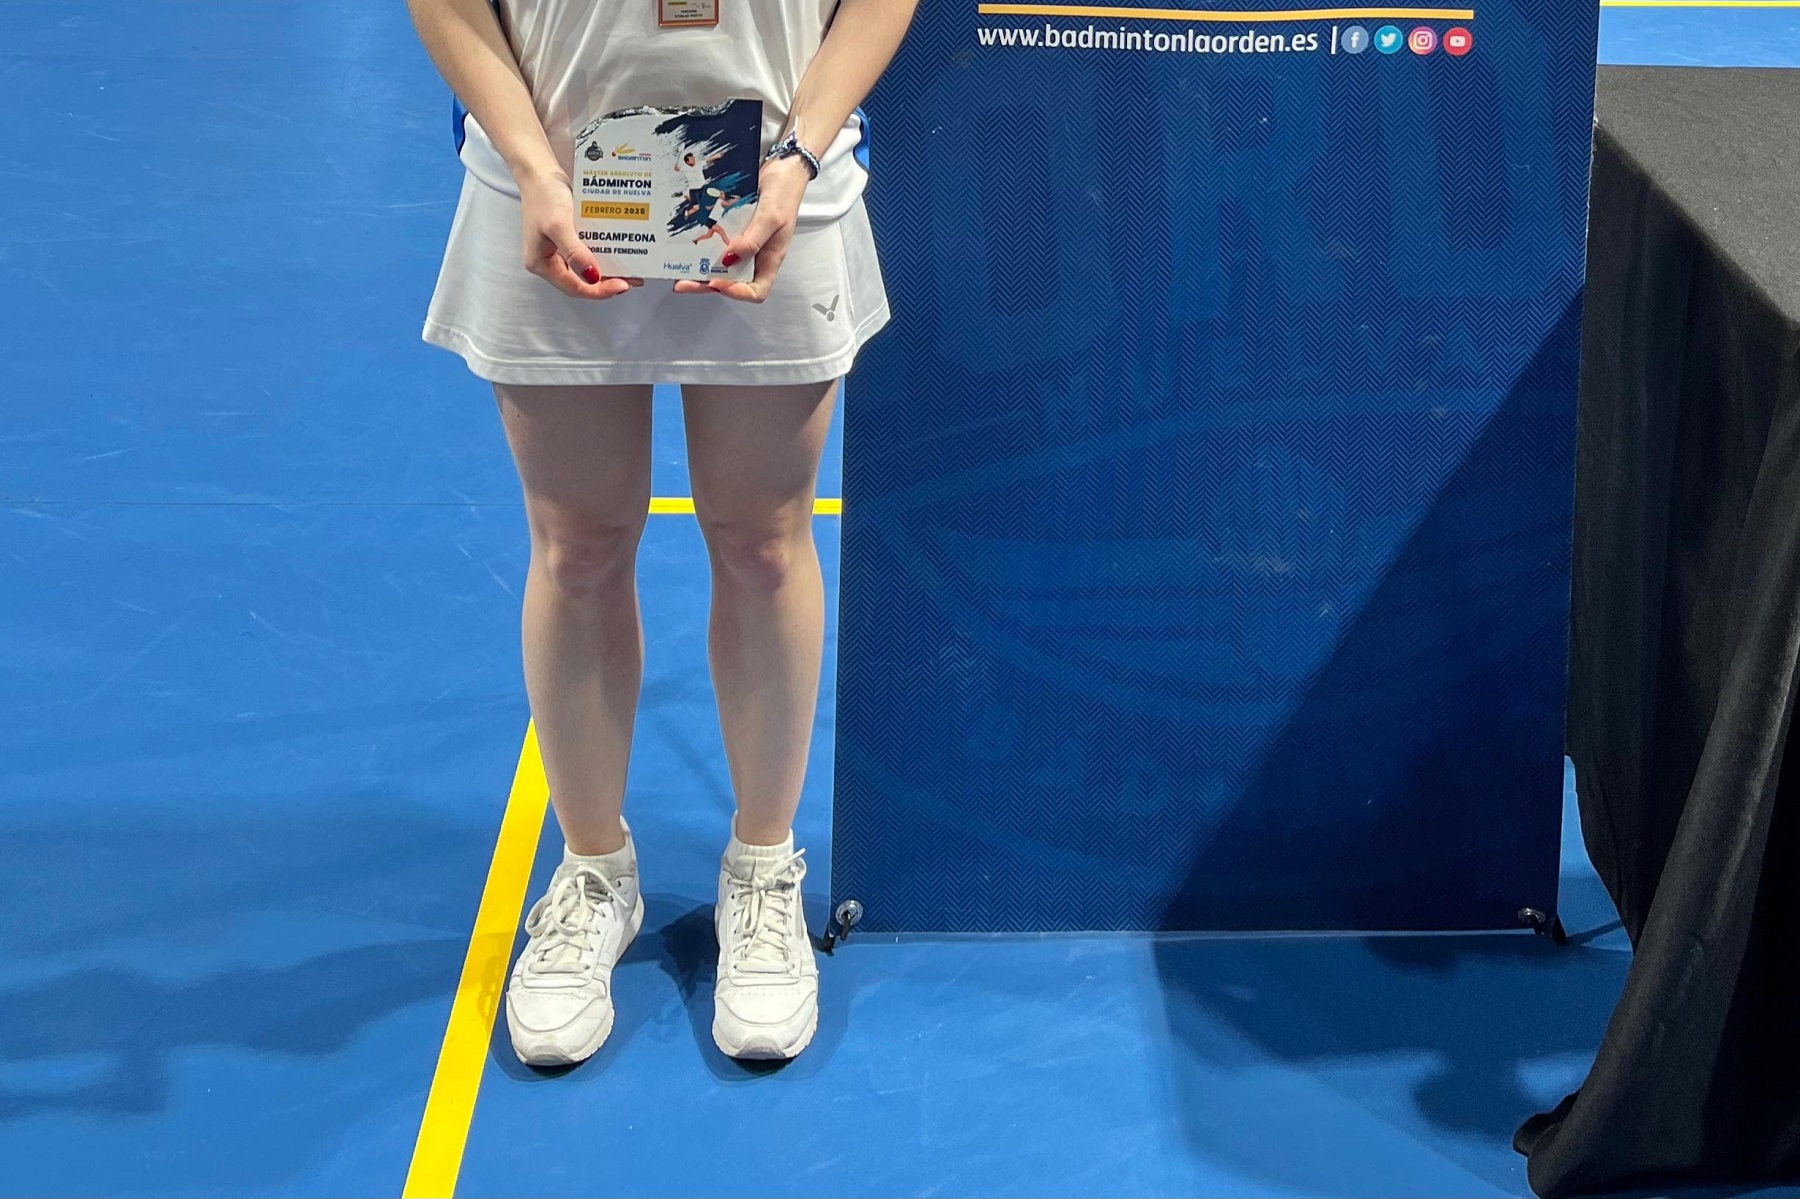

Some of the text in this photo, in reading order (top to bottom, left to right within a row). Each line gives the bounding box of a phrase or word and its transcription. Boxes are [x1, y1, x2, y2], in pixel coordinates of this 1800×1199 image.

[976, 24, 1319, 54] www.badmintonlaorden.es
[582, 175, 652, 189] BÁDMINTON
[582, 188, 611, 196] CIUDAD
[584, 206, 622, 214] FEBRERO
[578, 231, 656, 243] SUBCAMPEONA
[613, 247, 649, 255] FEMENINO
[663, 262, 690, 270] Huelva
